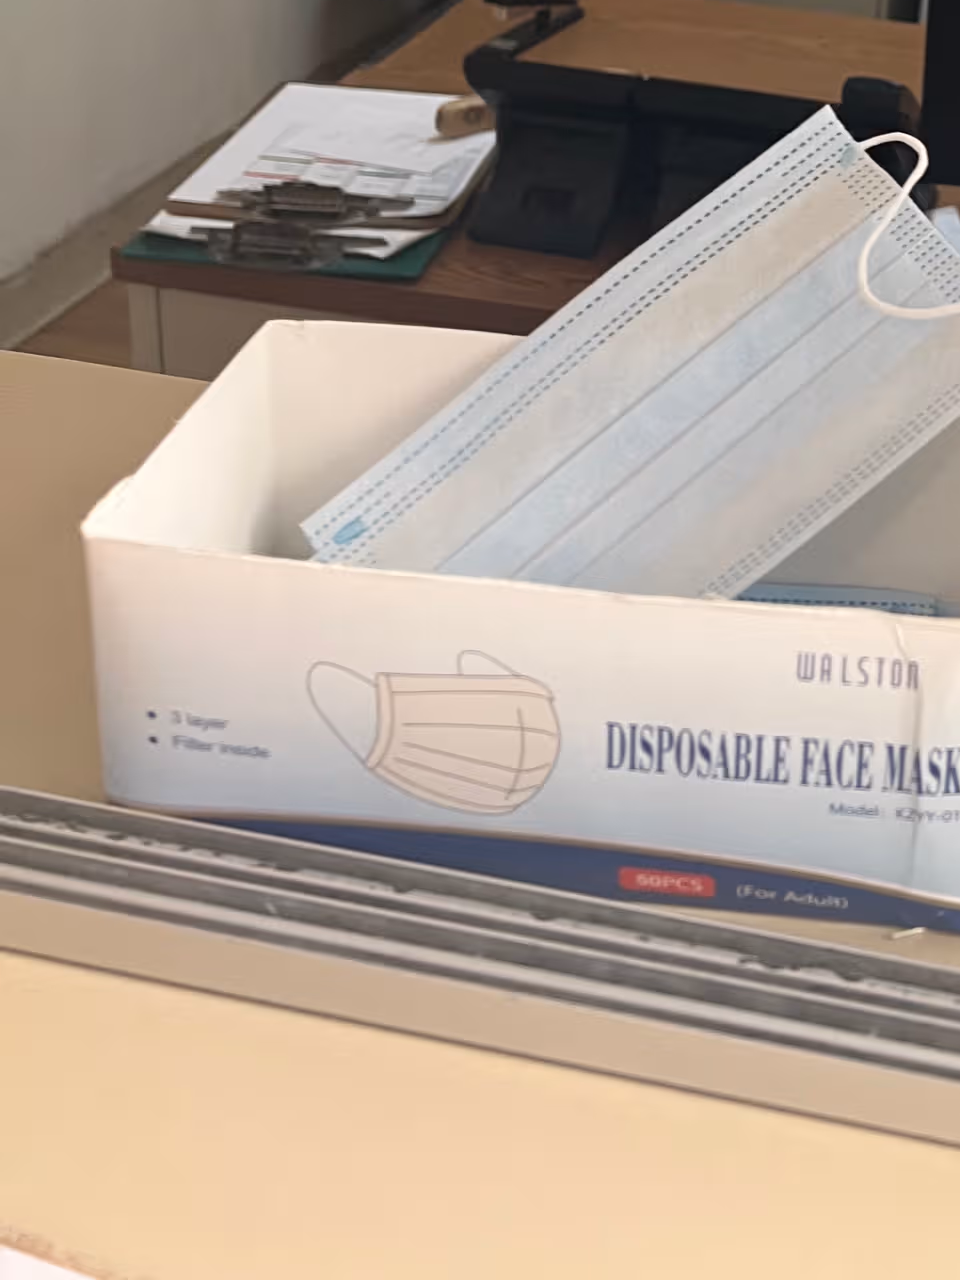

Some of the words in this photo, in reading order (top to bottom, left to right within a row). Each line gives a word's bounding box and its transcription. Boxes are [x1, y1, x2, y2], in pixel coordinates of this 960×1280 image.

[796, 651, 919, 690] WALSTON
[605, 720, 791, 784] DISPOSABLE
[800, 736, 873, 791] FACE
[736, 884, 777, 900] (For
[783, 889, 849, 909] Adult)
